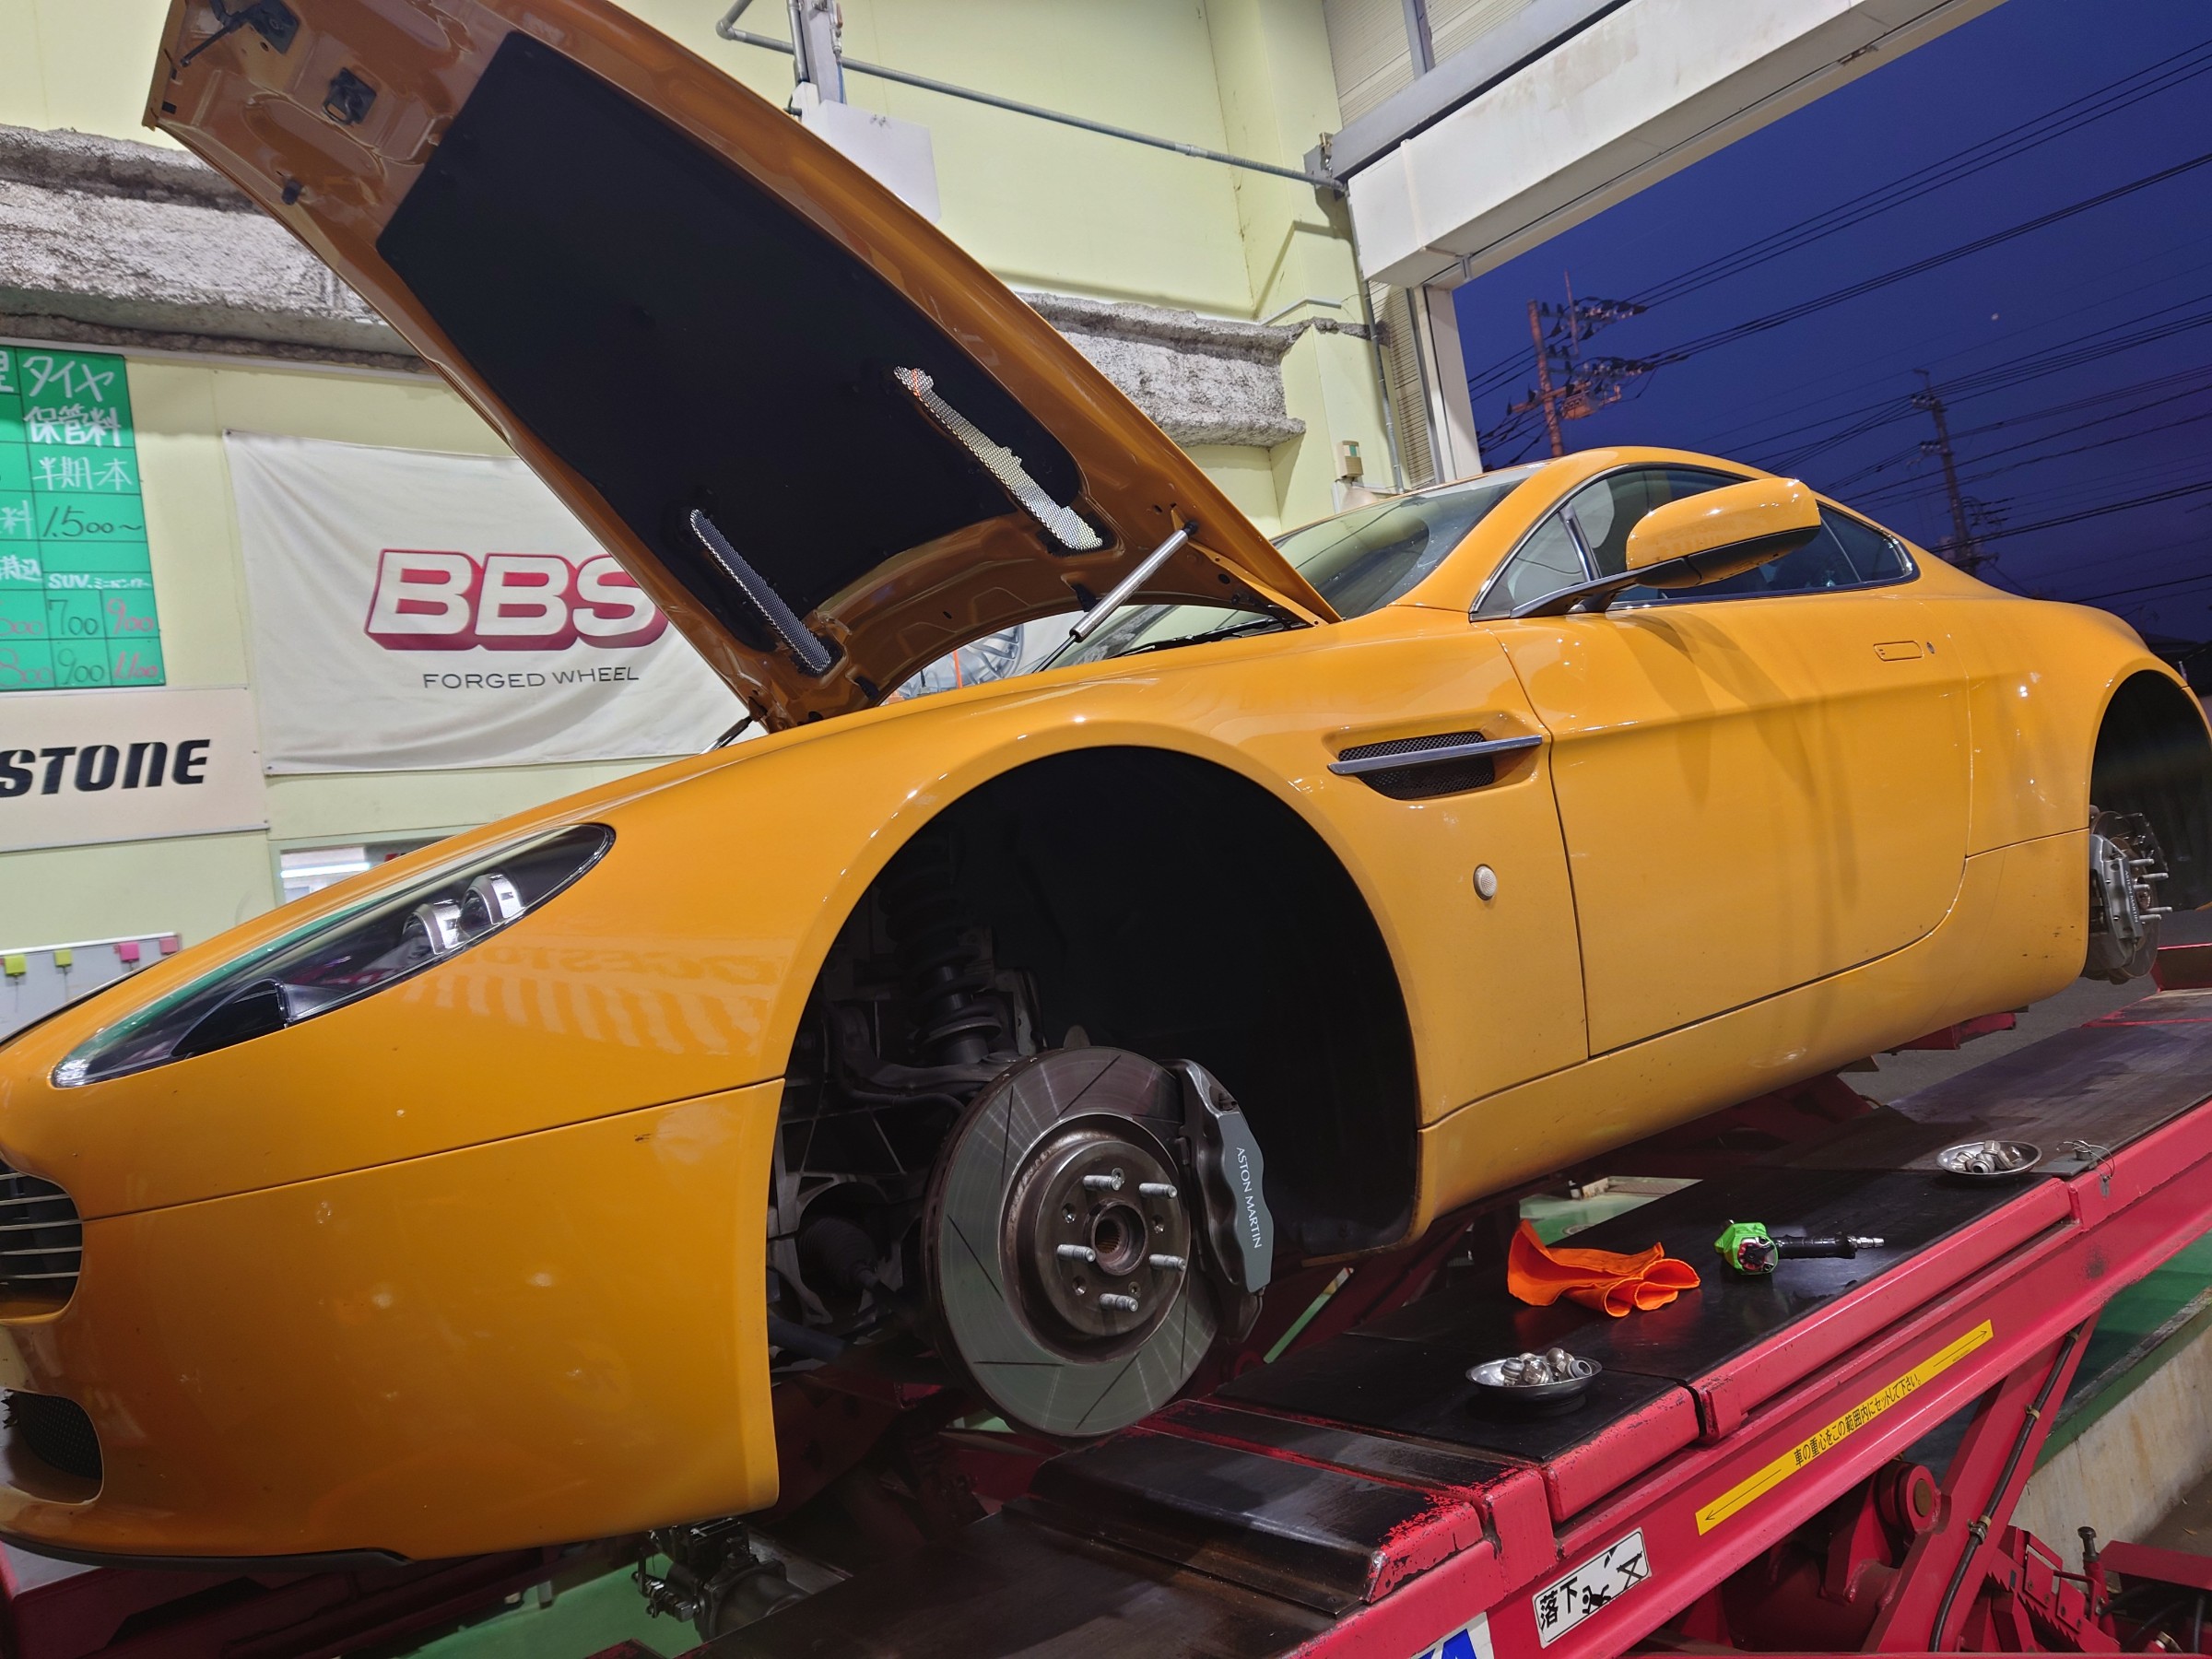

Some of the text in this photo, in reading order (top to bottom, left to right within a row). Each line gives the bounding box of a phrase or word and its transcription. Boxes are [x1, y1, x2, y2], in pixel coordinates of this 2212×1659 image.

[23, 355, 114, 402] タイヤ
[23, 403, 122, 447] 保管料
[48, 599, 99, 636] 700
[107, 598, 154, 635] 900
[364, 548, 669, 652] BBS
[422, 666, 640, 689] FORGED WHEEL
[1236, 1147, 1263, 1249] ASTON MARTIN
[1539, 1575, 1578, 1633] 落下
